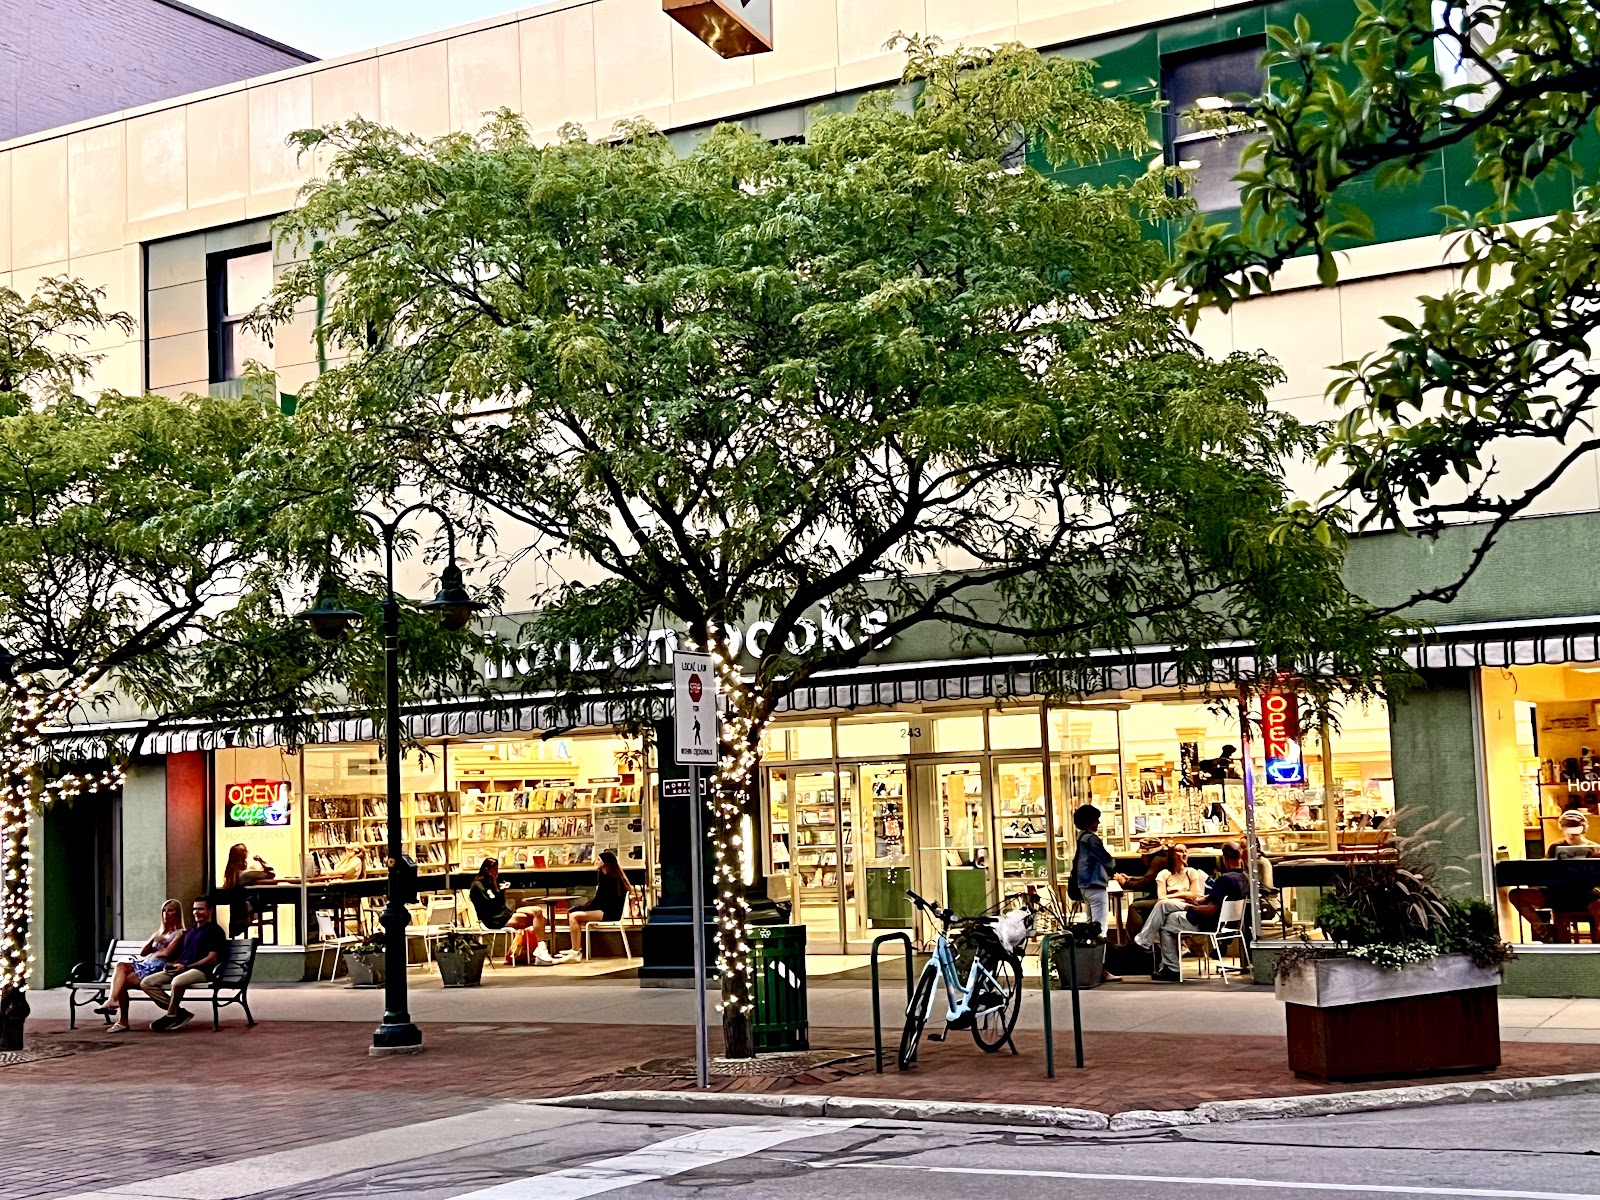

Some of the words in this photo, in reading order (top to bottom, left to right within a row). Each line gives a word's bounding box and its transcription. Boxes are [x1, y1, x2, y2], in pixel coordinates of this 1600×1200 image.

[900, 727, 922, 738] 243
[1266, 695, 1289, 758] OPEN
[229, 784, 278, 804] OPEN
[230, 803, 265, 825] Cafe
